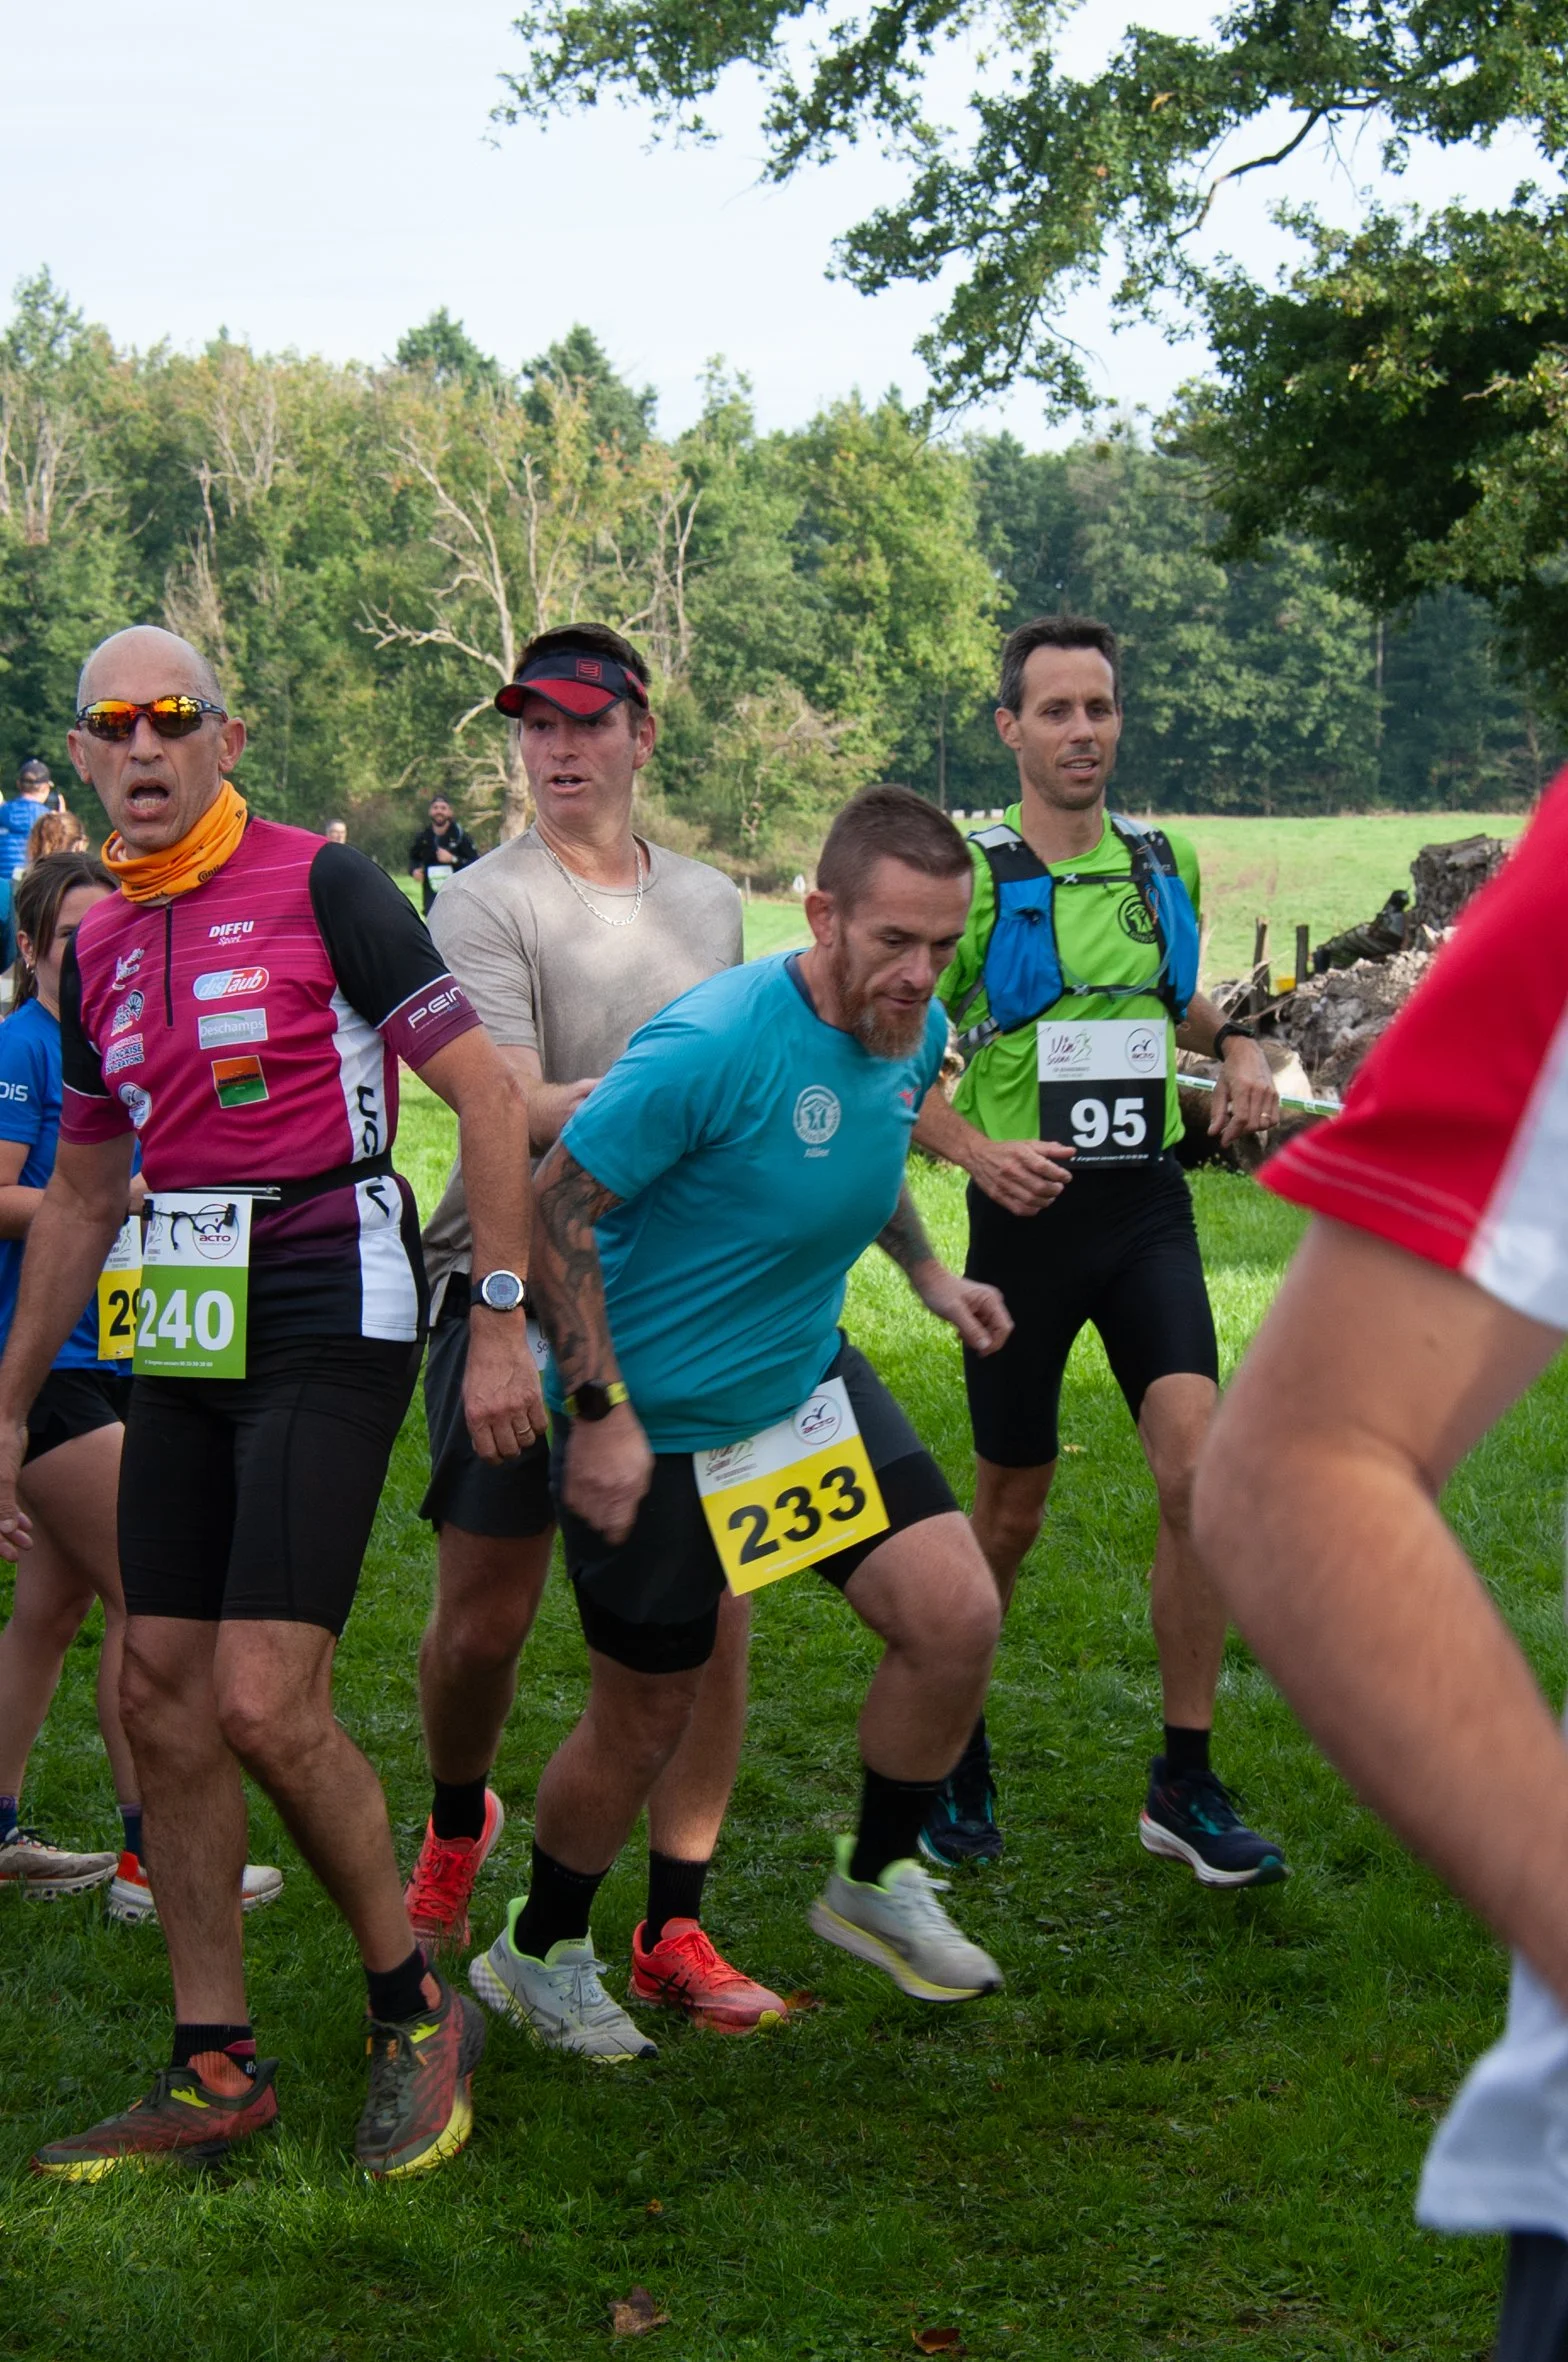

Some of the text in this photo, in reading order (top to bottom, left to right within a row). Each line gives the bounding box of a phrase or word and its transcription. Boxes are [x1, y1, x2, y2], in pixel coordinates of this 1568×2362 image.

[208, 920, 254, 938] DIFFU
[201, 1020, 264, 1037] Deschamps
[1070, 1097, 1147, 1148] 95
[137, 1288, 235, 1351] 240
[727, 1466, 867, 1565] 233
